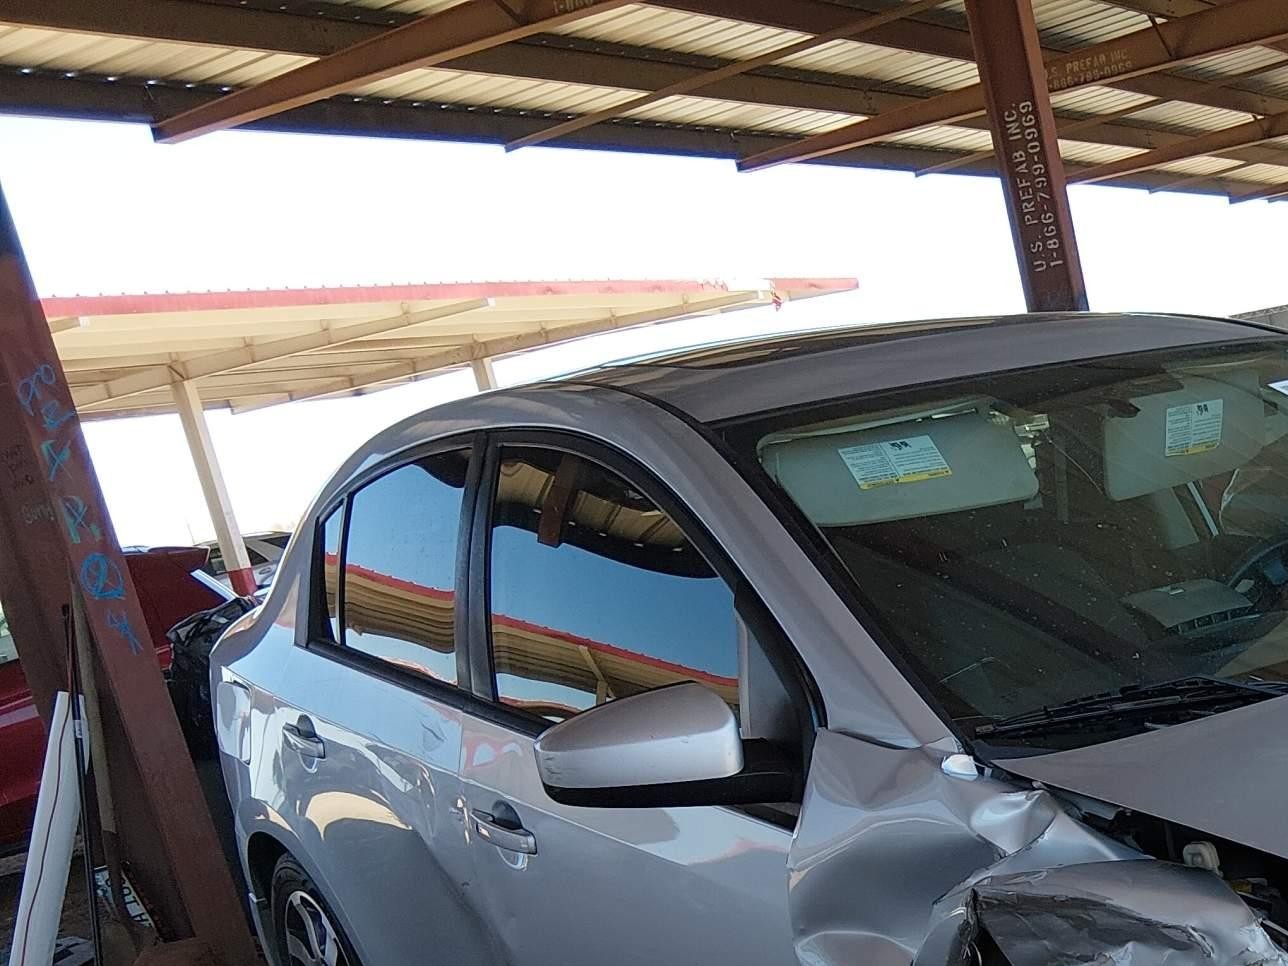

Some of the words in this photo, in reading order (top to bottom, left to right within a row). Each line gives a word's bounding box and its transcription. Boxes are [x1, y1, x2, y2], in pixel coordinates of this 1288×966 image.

[1004, 103, 1021, 141] INC.
[1013, 151, 1038, 226] PREFAB
[1020, 101, 1064, 267] 1-866-799-0969
[1031, 235, 1047, 272] U.S.
